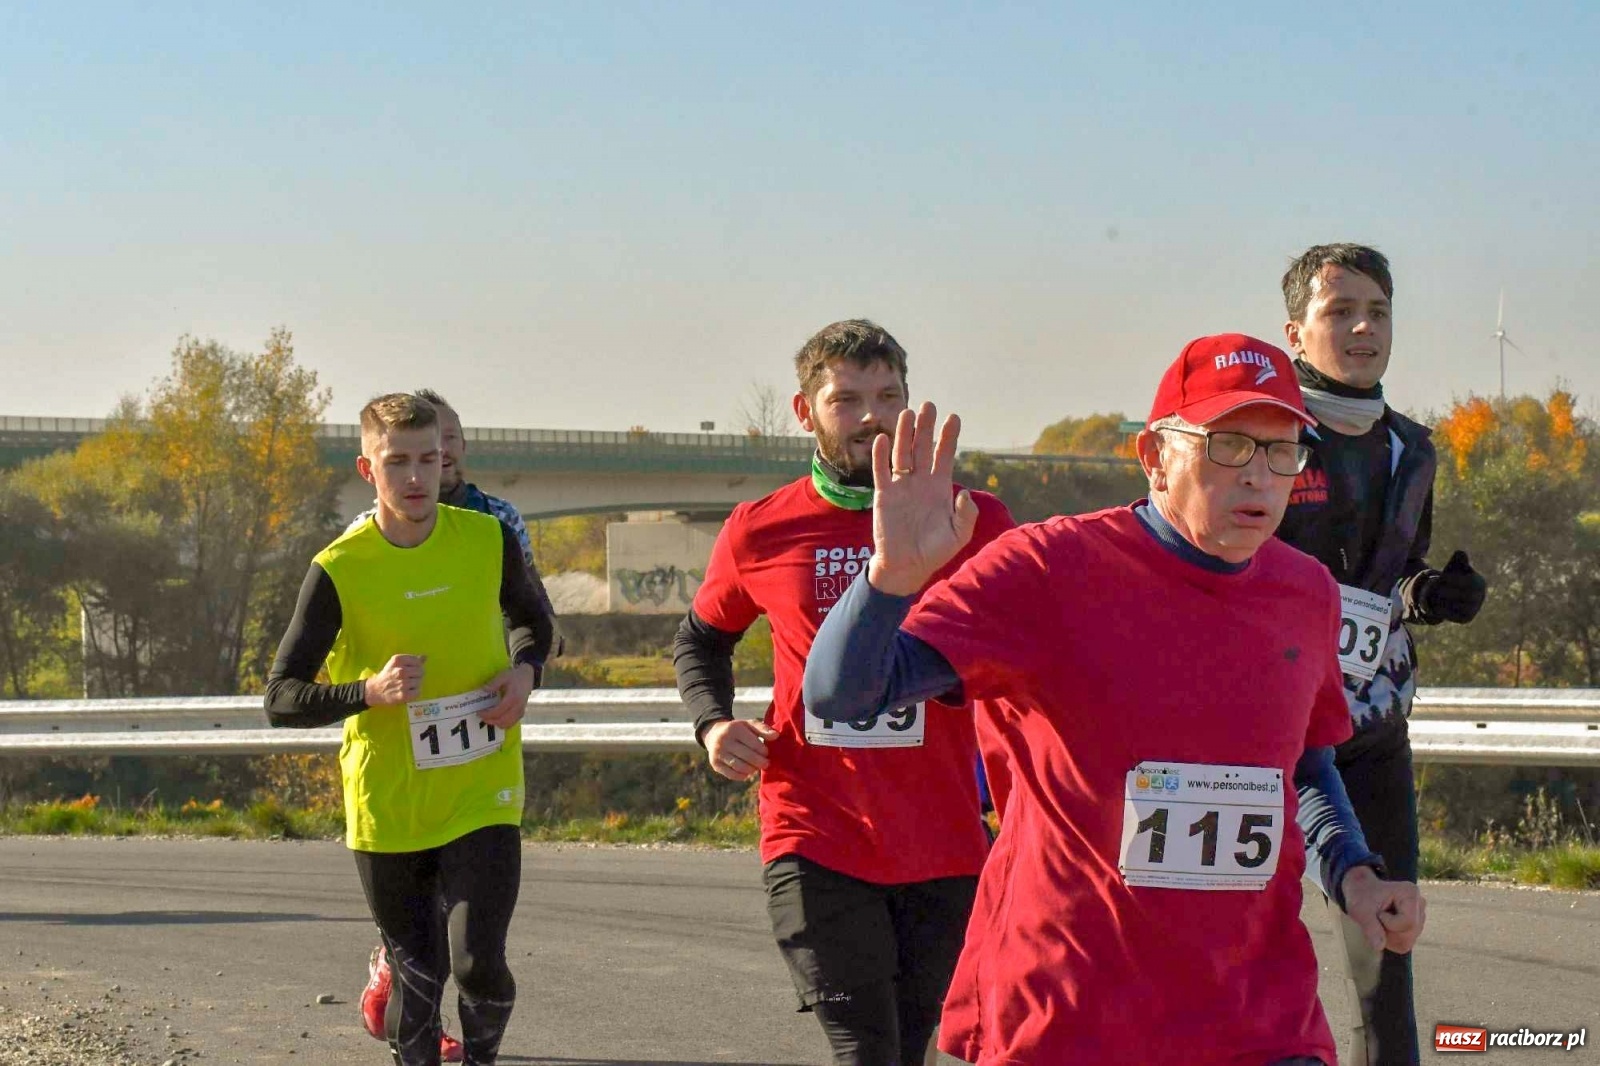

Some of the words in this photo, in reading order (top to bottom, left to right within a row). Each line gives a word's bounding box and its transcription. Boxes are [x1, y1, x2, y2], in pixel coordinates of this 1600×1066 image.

[1215, 351, 1272, 369] RAUCH
[420, 719, 496, 755] 111
[1187, 778, 1279, 794] www.personalbest.pl
[1136, 808, 1273, 869] 115
